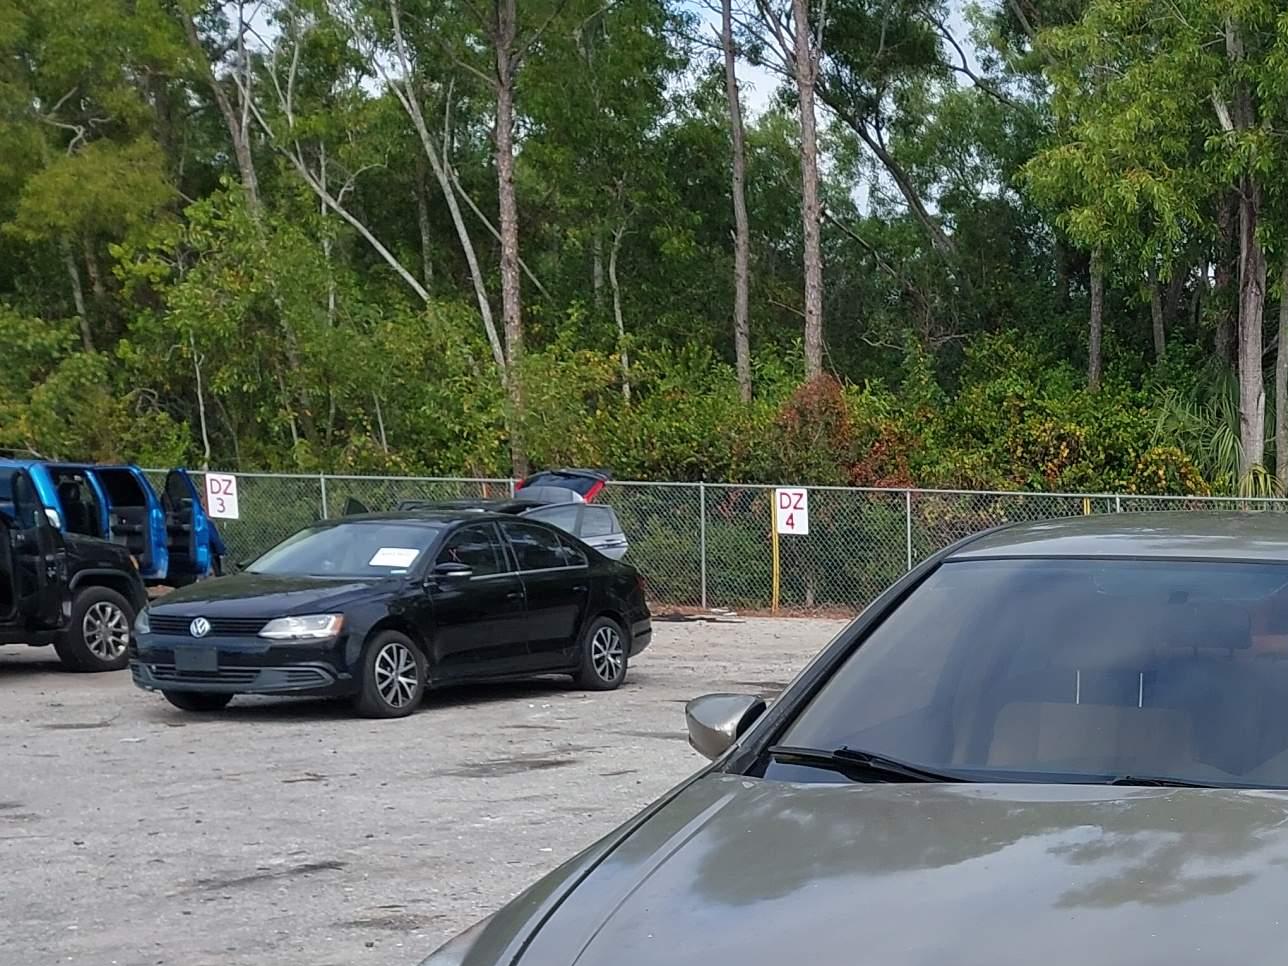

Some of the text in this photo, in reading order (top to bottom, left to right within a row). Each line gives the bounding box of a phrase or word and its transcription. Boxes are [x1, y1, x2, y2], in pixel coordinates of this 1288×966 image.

[209, 478, 234, 496] DZ
[216, 497, 226, 513] 3
[779, 492, 804, 510] DZ
[785, 512, 795, 530] 4
